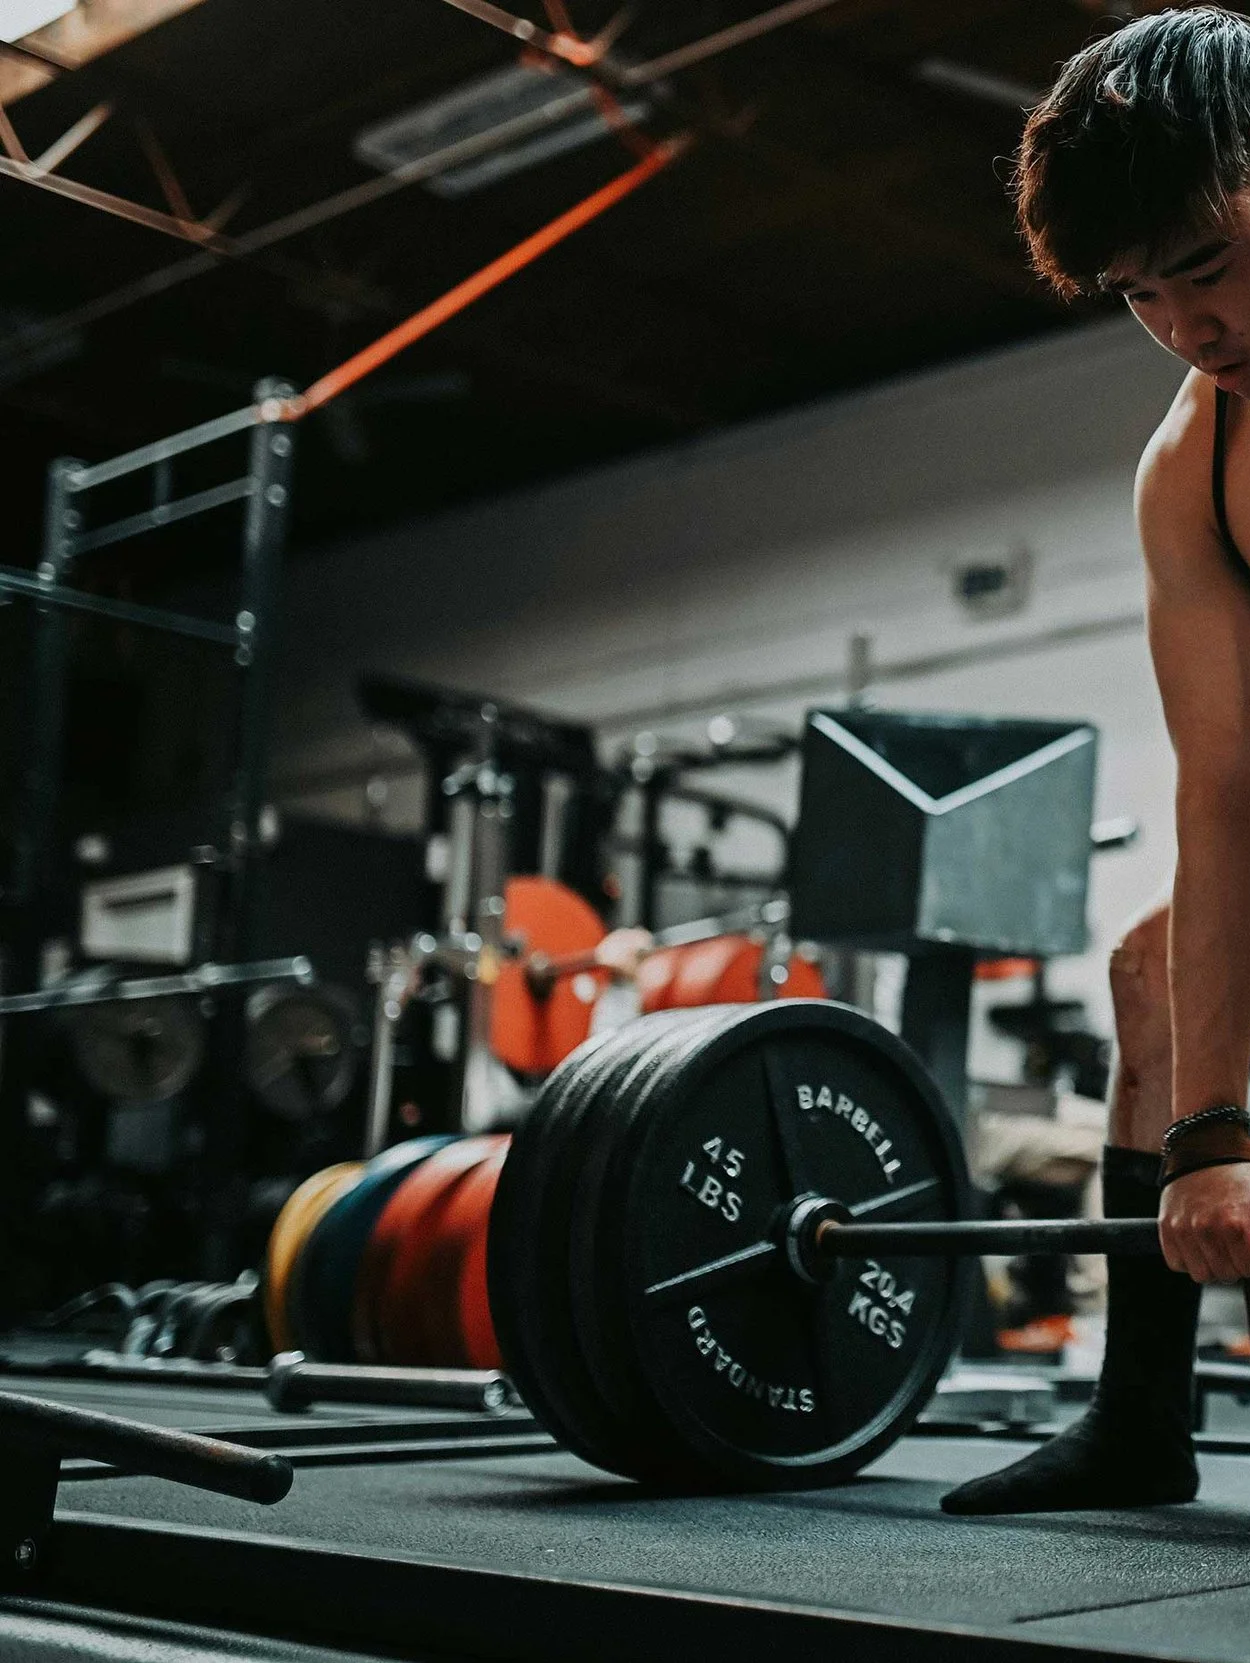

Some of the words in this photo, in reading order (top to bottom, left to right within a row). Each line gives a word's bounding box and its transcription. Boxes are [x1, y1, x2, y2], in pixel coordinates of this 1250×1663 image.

[702, 1136, 746, 1177] 45
[796, 1084, 901, 1184] BARBELL
[680, 1160, 743, 1222] LBS
[848, 1290, 906, 1348] KGS
[688, 1305, 816, 1412] STANDARD
